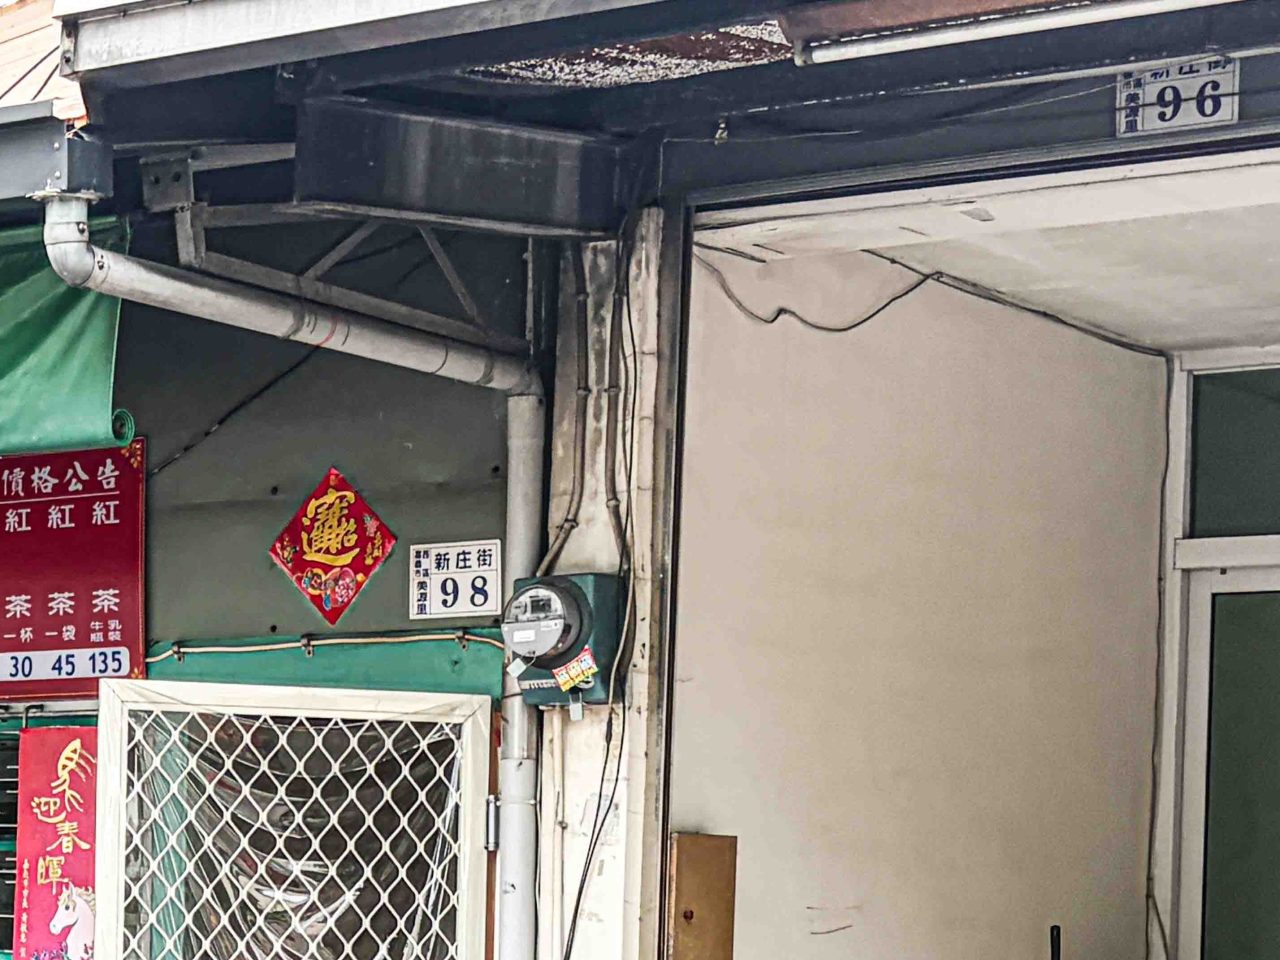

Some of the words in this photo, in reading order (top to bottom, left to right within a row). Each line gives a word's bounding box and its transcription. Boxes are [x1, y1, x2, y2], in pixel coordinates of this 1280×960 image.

[1156, 79, 1222, 122] 96
[434, 548, 493, 571] 新庄街
[440, 575, 489, 609] 98
[3, 627, 34, 643] 一杯
[45, 625, 76, 641] 一袋
[9, 655, 33, 678] 30
[51, 654, 76, 676] 45
[88, 650, 122, 674] 135
